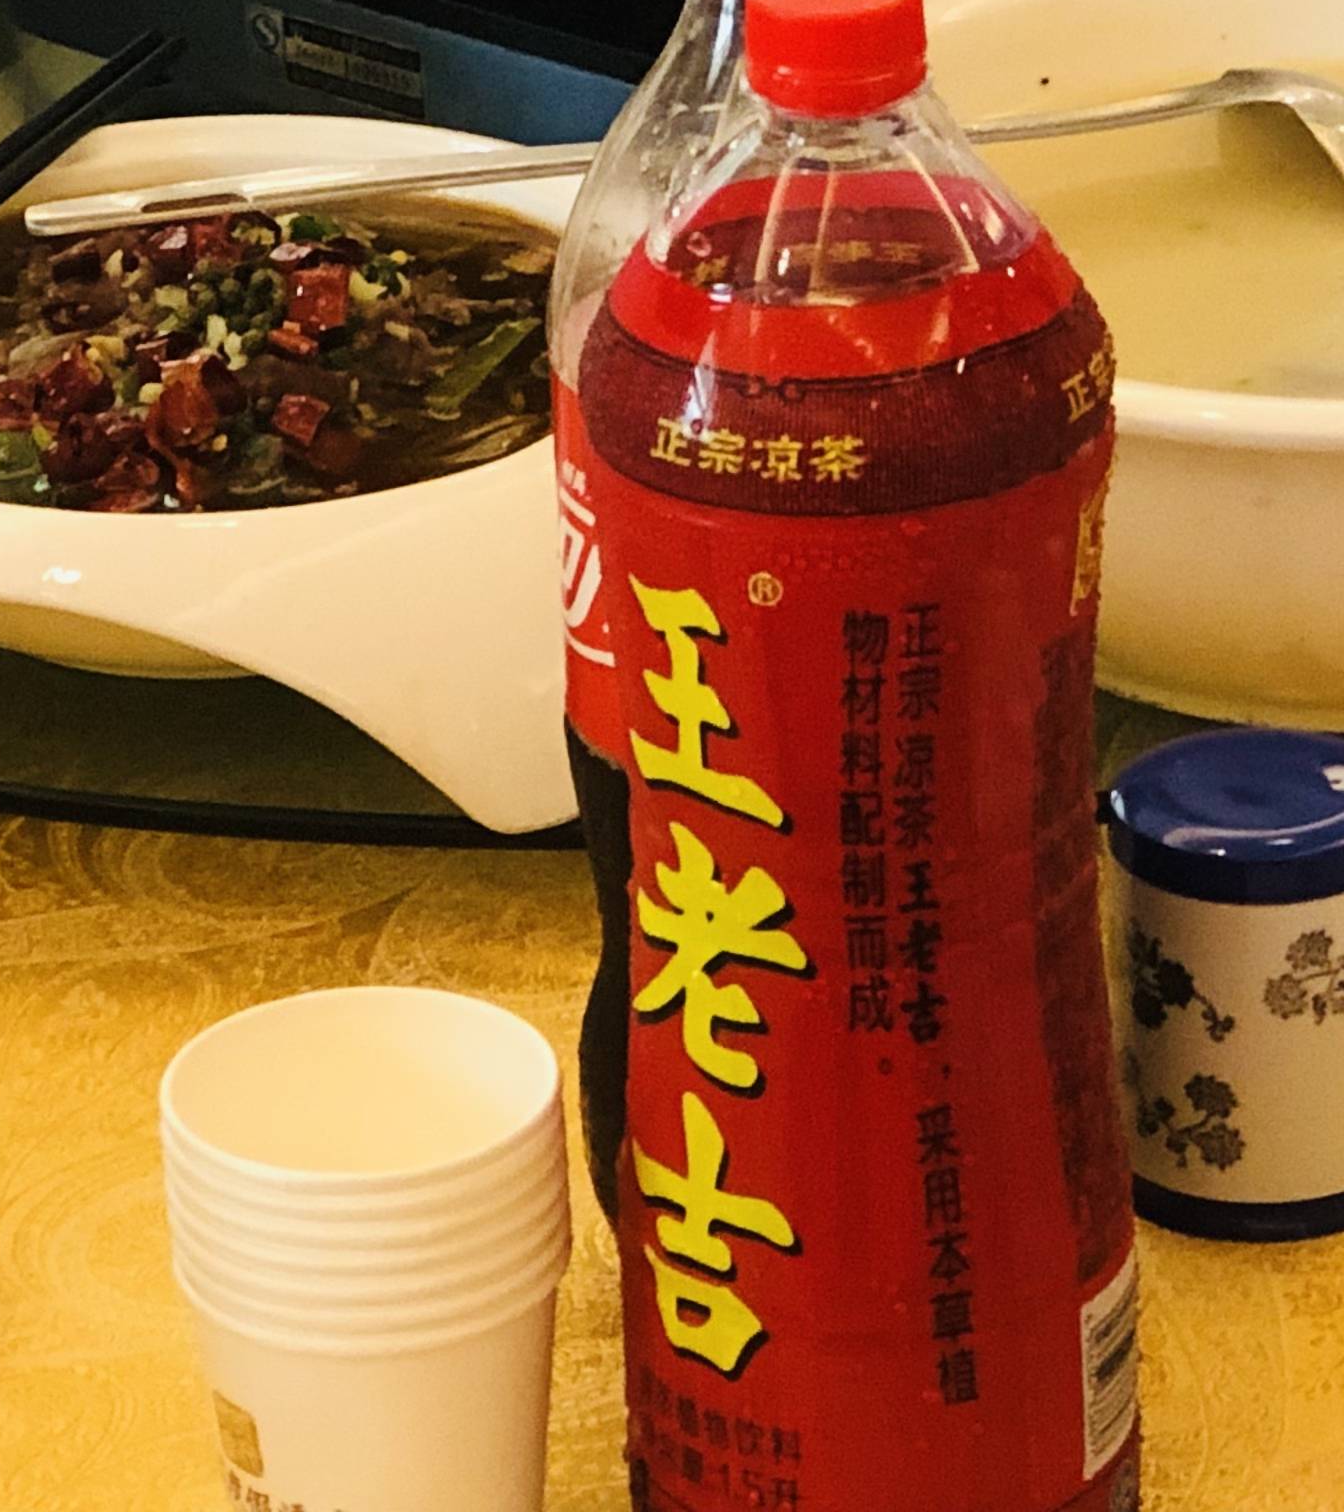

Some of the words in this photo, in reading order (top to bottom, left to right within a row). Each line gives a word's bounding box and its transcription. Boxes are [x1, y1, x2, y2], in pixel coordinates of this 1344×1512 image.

[649, 416, 866, 482] 正宗凉茶
[628, 571, 814, 1377] 王老吉
